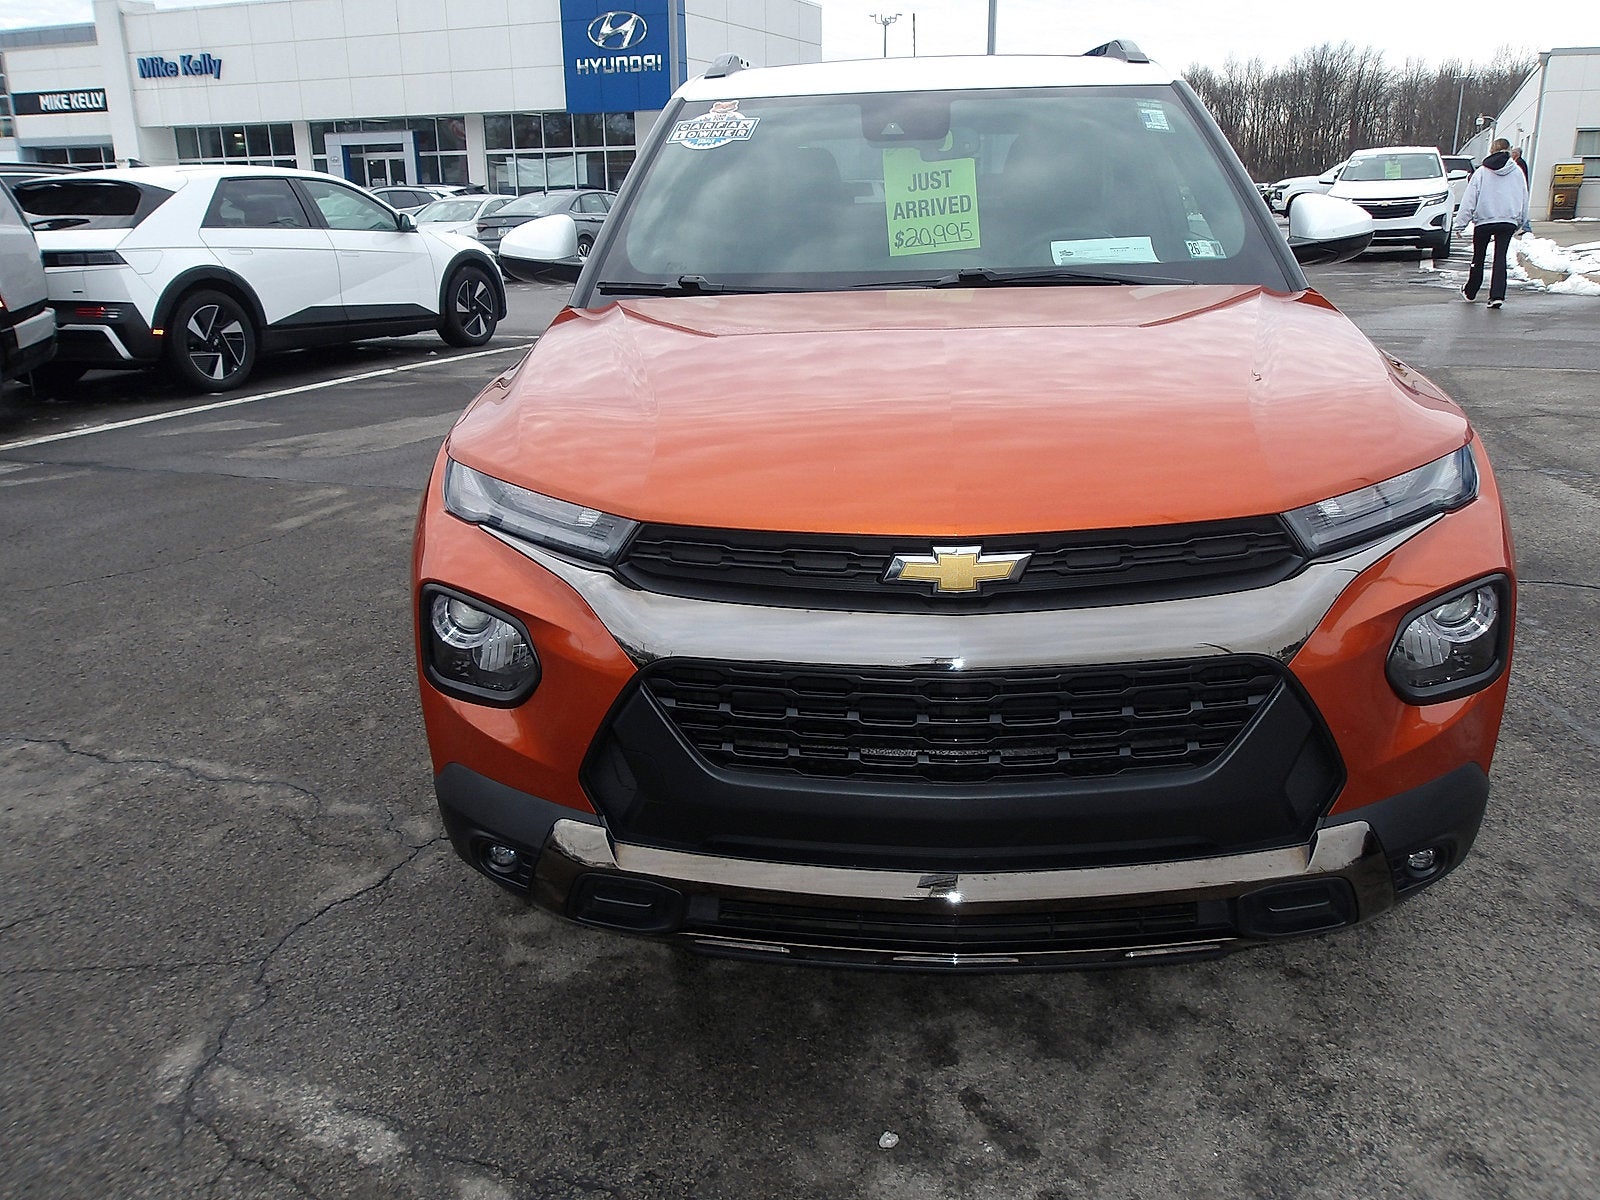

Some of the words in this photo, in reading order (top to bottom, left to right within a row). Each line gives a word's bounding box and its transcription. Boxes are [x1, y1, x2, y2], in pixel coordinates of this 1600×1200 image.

[137, 56, 178, 78] Mike
[180, 53, 222, 79] Kelly
[576, 54, 662, 75] HYUNDAI
[38, 93, 69, 112] MIKE
[69, 91, 104, 110] KELLY
[679, 121, 750, 131] CARFAX
[686, 129, 748, 138] OWNER
[907, 169, 952, 193] JUST
[893, 194, 972, 221] ARRIVED
[894, 221, 974, 249] $20,995
